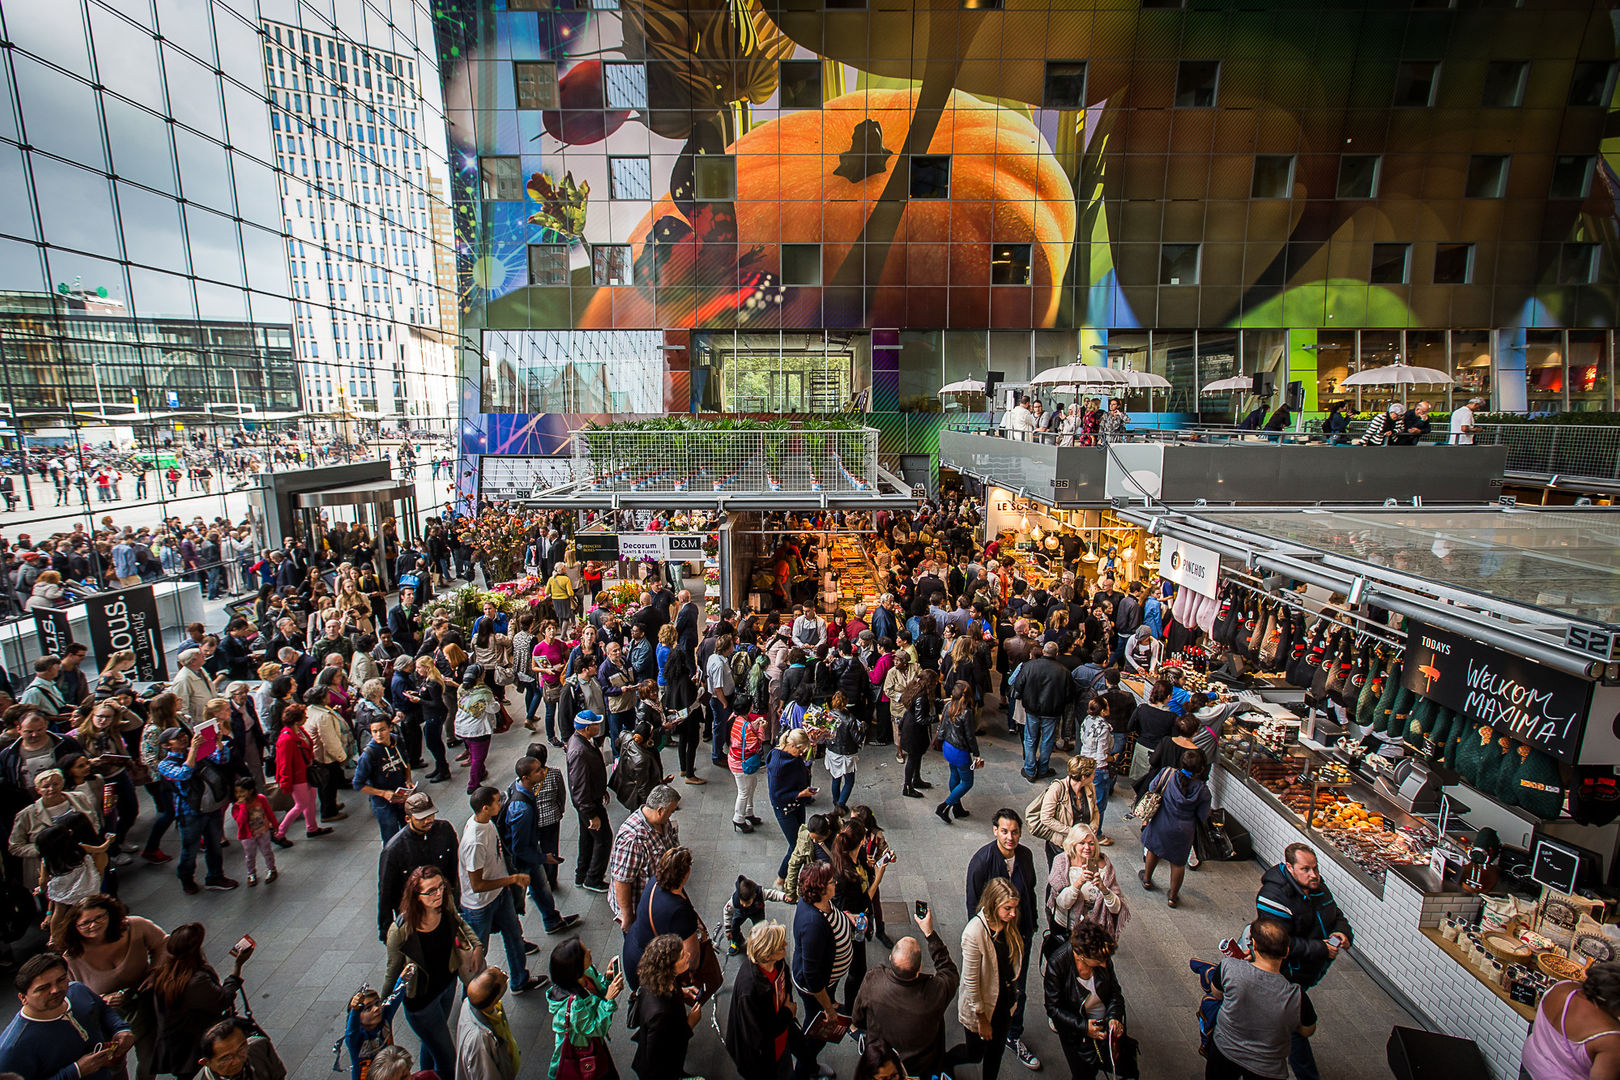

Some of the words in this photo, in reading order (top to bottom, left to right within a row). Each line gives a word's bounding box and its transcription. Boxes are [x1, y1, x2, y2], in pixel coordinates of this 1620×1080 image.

[997, 503, 1007, 511] LE
[672, 540, 698, 549] D&M
[1183, 559, 1206, 579] PINCHOS
[1421, 635, 1451, 655] TODAYS
[141, 662, 154, 681] oet
[1465, 658, 1565, 721] WELKOM
[1464, 690, 1577, 755] MAXIMA!
